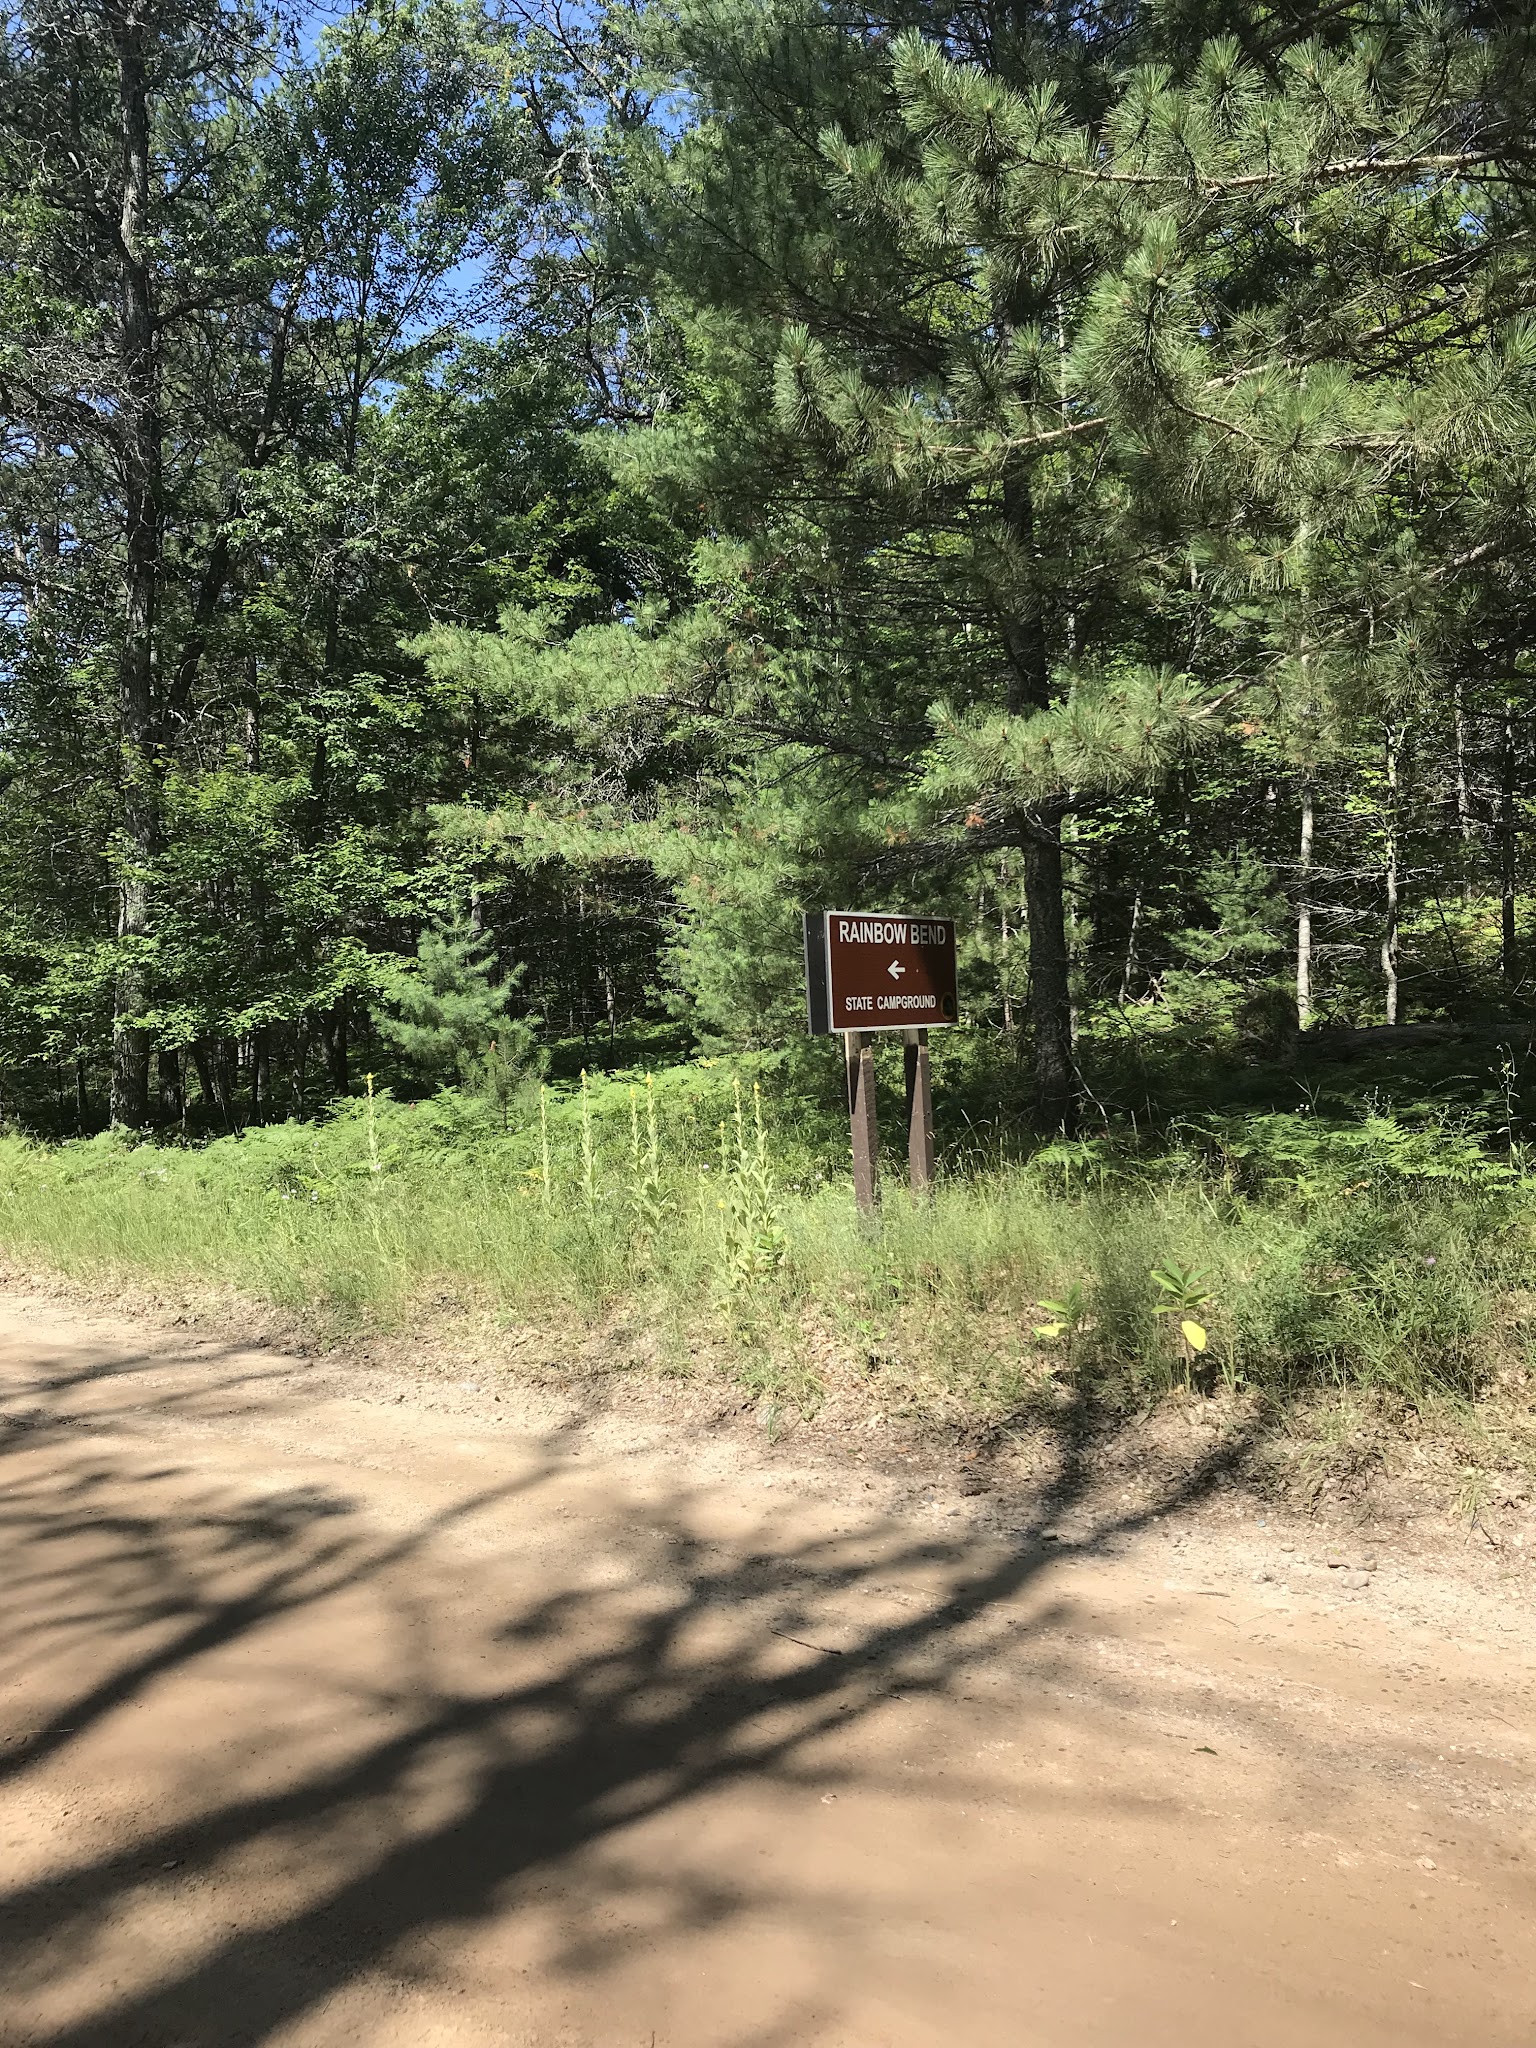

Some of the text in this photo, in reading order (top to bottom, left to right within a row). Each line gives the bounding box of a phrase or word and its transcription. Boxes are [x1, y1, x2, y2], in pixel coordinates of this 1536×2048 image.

[839, 920, 946, 945] RAINBOW BEND
[845, 995, 937, 1011] STATE CAMPGROUND
